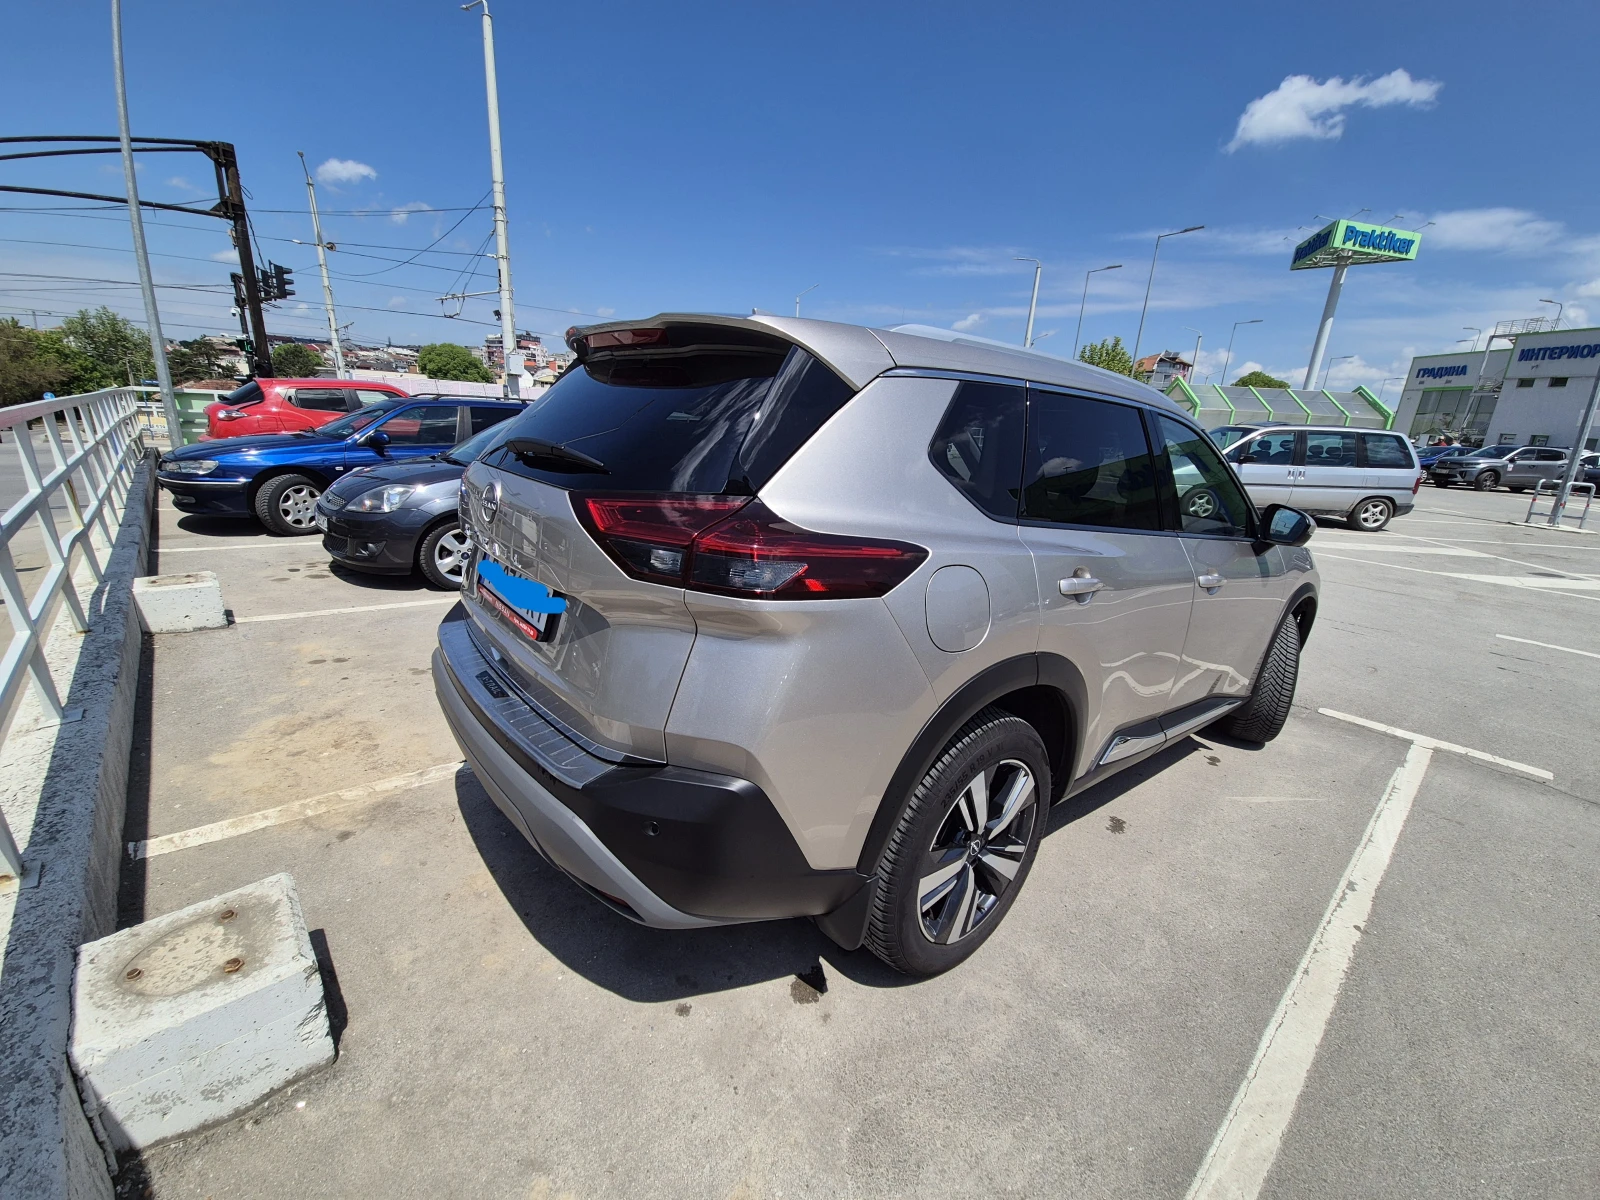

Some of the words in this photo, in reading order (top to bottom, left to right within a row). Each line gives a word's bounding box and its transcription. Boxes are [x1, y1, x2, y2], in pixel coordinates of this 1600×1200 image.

[1343, 225, 1416, 256] Praktiker
[1416, 365, 1468, 379] ГРАДИНА
[481, 499, 498, 512] SSAN
[941, 771, 969, 809] 235/55
